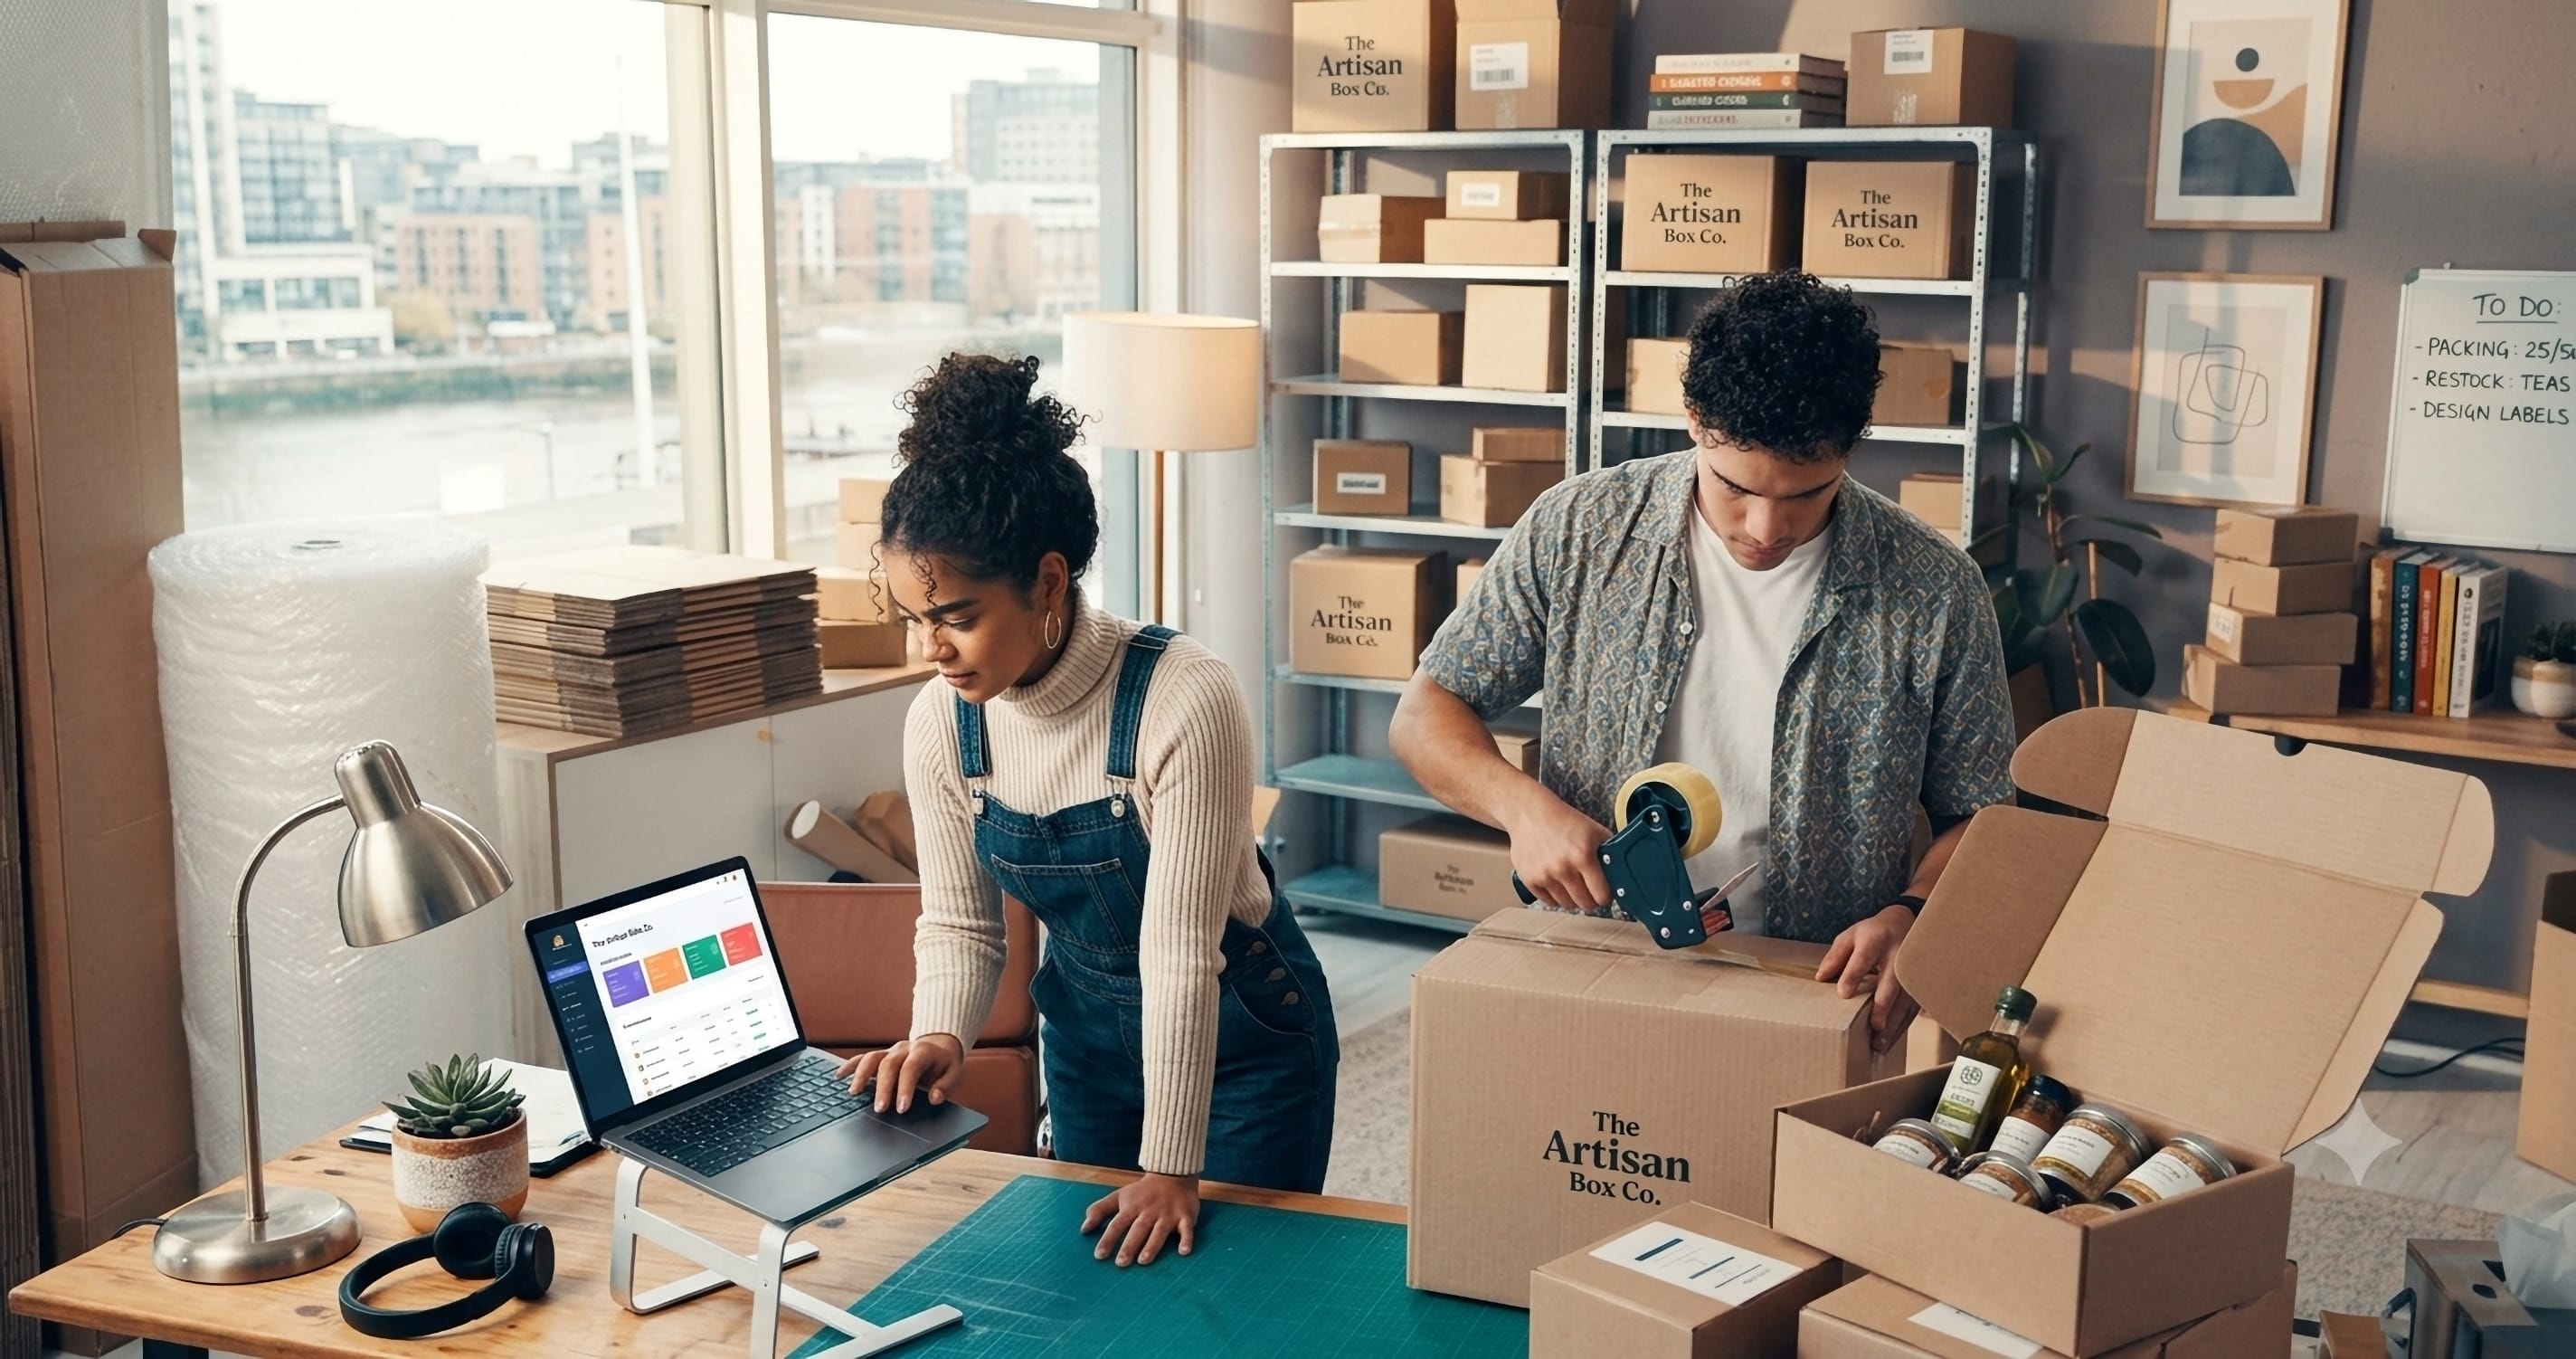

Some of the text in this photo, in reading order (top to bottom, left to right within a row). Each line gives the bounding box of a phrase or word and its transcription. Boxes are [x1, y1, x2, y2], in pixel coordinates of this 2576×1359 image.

[1345, 35, 1375, 52] The
[1317, 55, 1403, 77] Artisan
[1680, 182, 1712, 198] The
[1860, 189, 1891, 204] The
[1651, 201, 1741, 224] Artisan
[1832, 207, 1918, 230] Artisan
[1664, 228, 1727, 244] Box Co.
[1844, 233, 1905, 249] Box Co.
[2472, 292, 2562, 318] TO DO:
[2520, 374, 2571, 393] TEAS
[2423, 400, 2490, 423] DESIGN
[2500, 405, 2570, 425] LABELS
[1310, 609, 1392, 632] Artisan
[1592, 1110, 1641, 1137] The
[1542, 1129, 1690, 1183] Artisan
[1569, 1171, 1662, 1206] Box Co.
